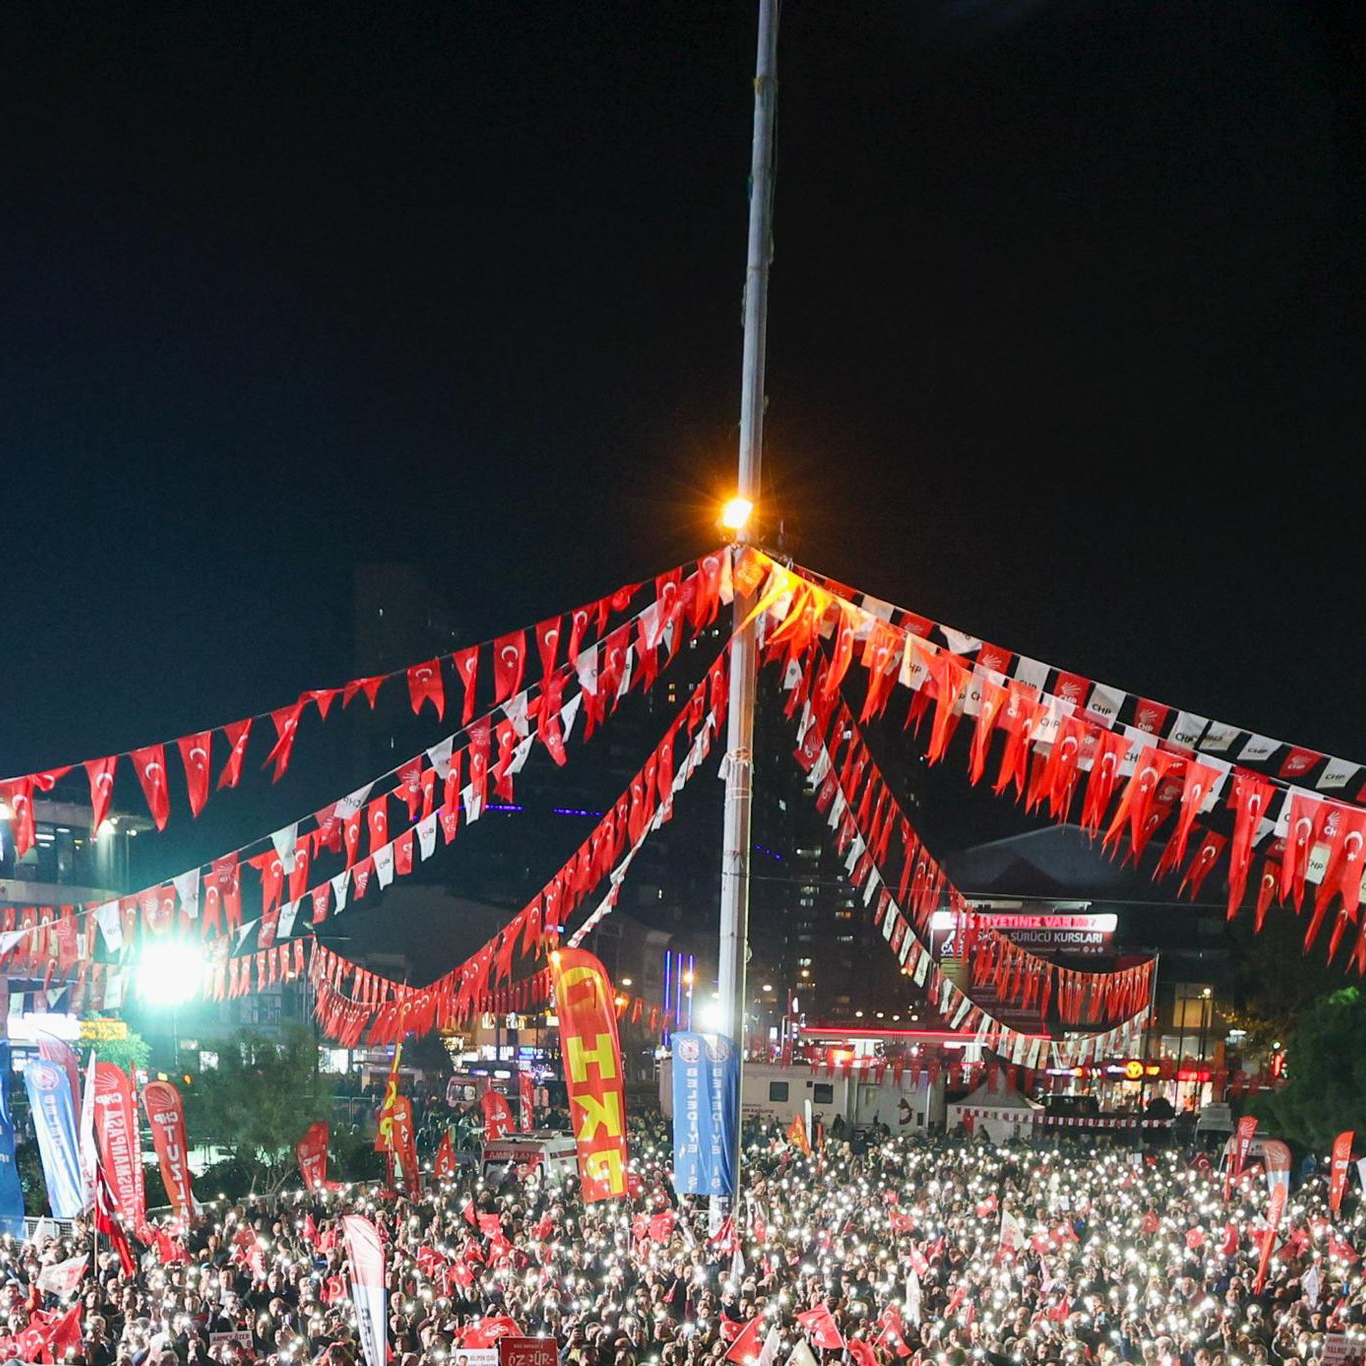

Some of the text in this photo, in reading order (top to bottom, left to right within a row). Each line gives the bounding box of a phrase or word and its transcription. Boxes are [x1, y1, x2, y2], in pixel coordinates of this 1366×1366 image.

[1091, 703, 1113, 715] CHP
[1175, 732, 1195, 744] CHP
[1054, 932, 1103, 943] KURSLARI
